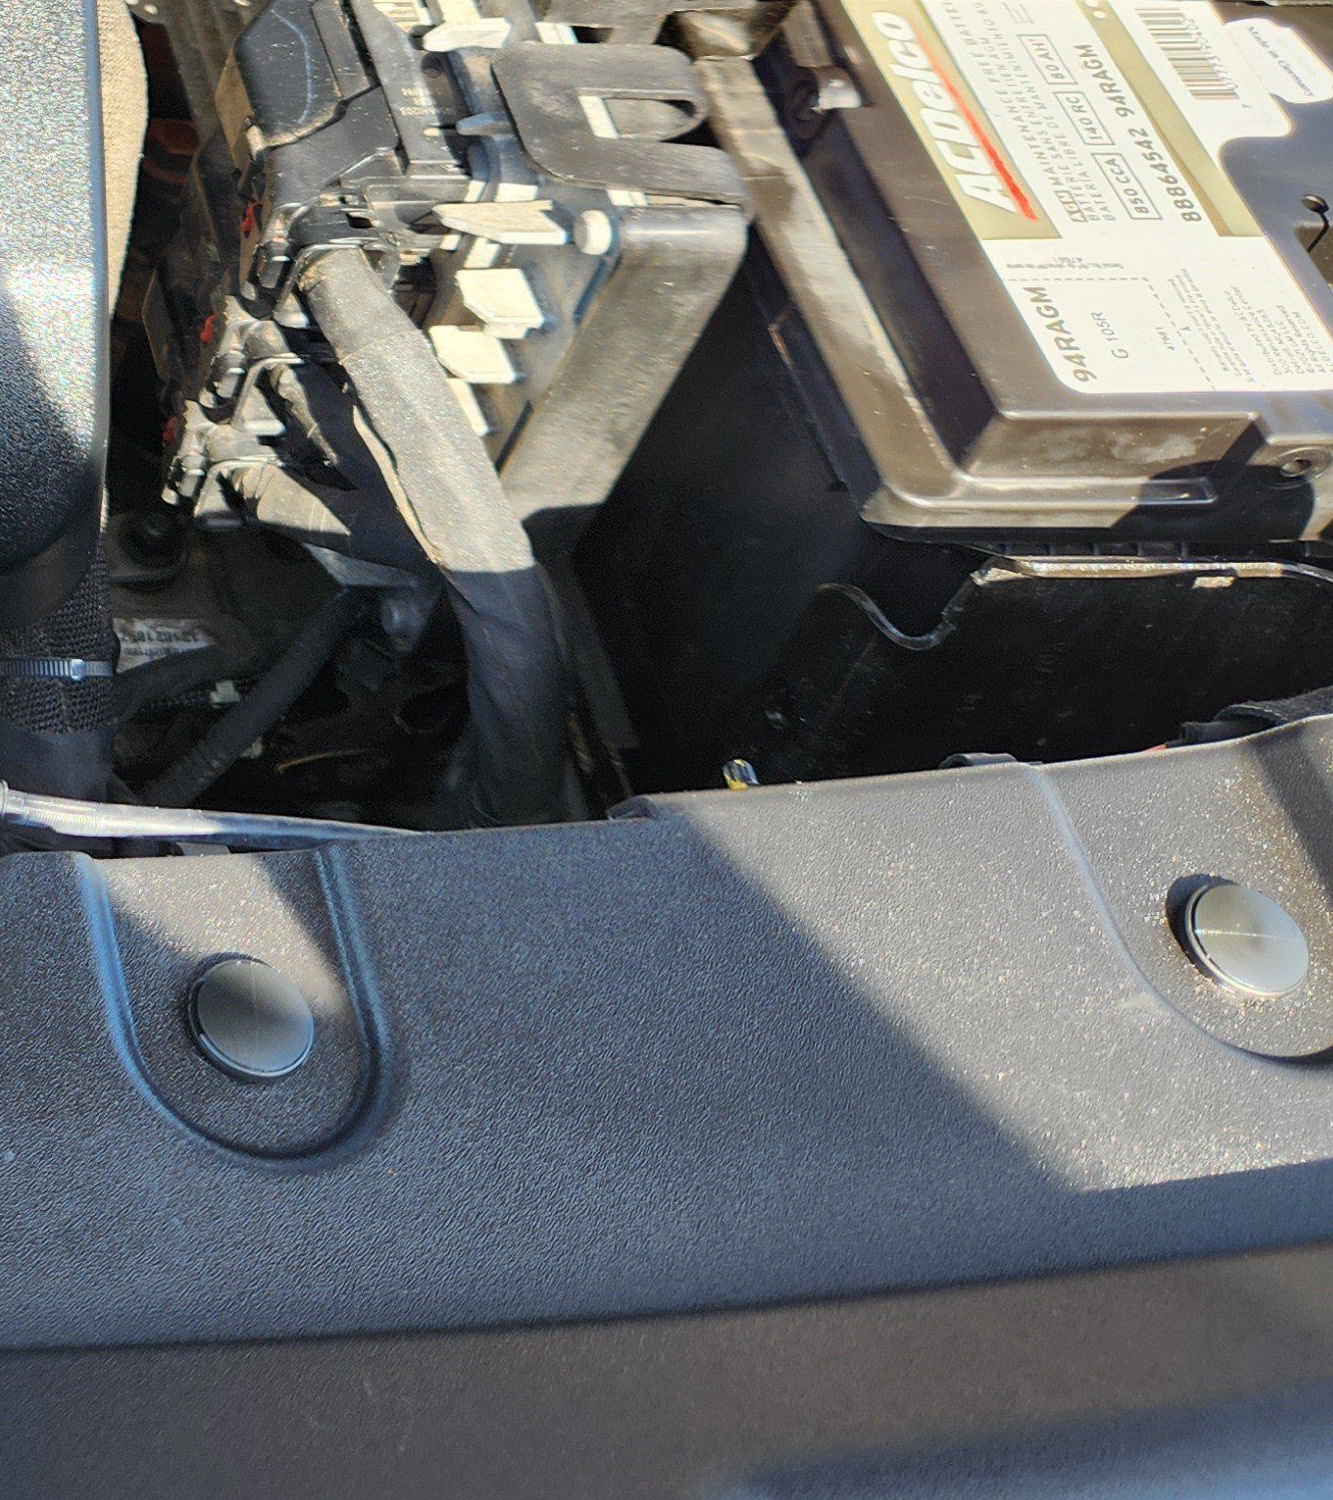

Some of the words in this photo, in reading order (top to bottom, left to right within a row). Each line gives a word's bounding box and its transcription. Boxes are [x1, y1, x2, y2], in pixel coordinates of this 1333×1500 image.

[971, 52, 999, 81] FREE
[1044, 64, 1066, 79] 80
[1072, 44, 1137, 116] 94RAGM
[873, 11, 1018, 213] ACDelco
[1064, 96, 1087, 113] RC
[1040, 115, 1059, 127] DE
[1078, 118, 1104, 139] 140
[993, 88, 1063, 185] MAINTENANCE
[1034, 131, 1063, 158] SANS
[1051, 133, 1083, 165] LIBRE
[1102, 158, 1131, 182] CCA
[1125, 128, 1203, 221] 88864542
[1056, 165, 1100, 220] BATTERIE
[1122, 188, 1150, 213] 850
[1021, 286, 1100, 382] 94RAGM
[1090, 311, 1120, 341] 105R
[1109, 348, 1130, 358] G
